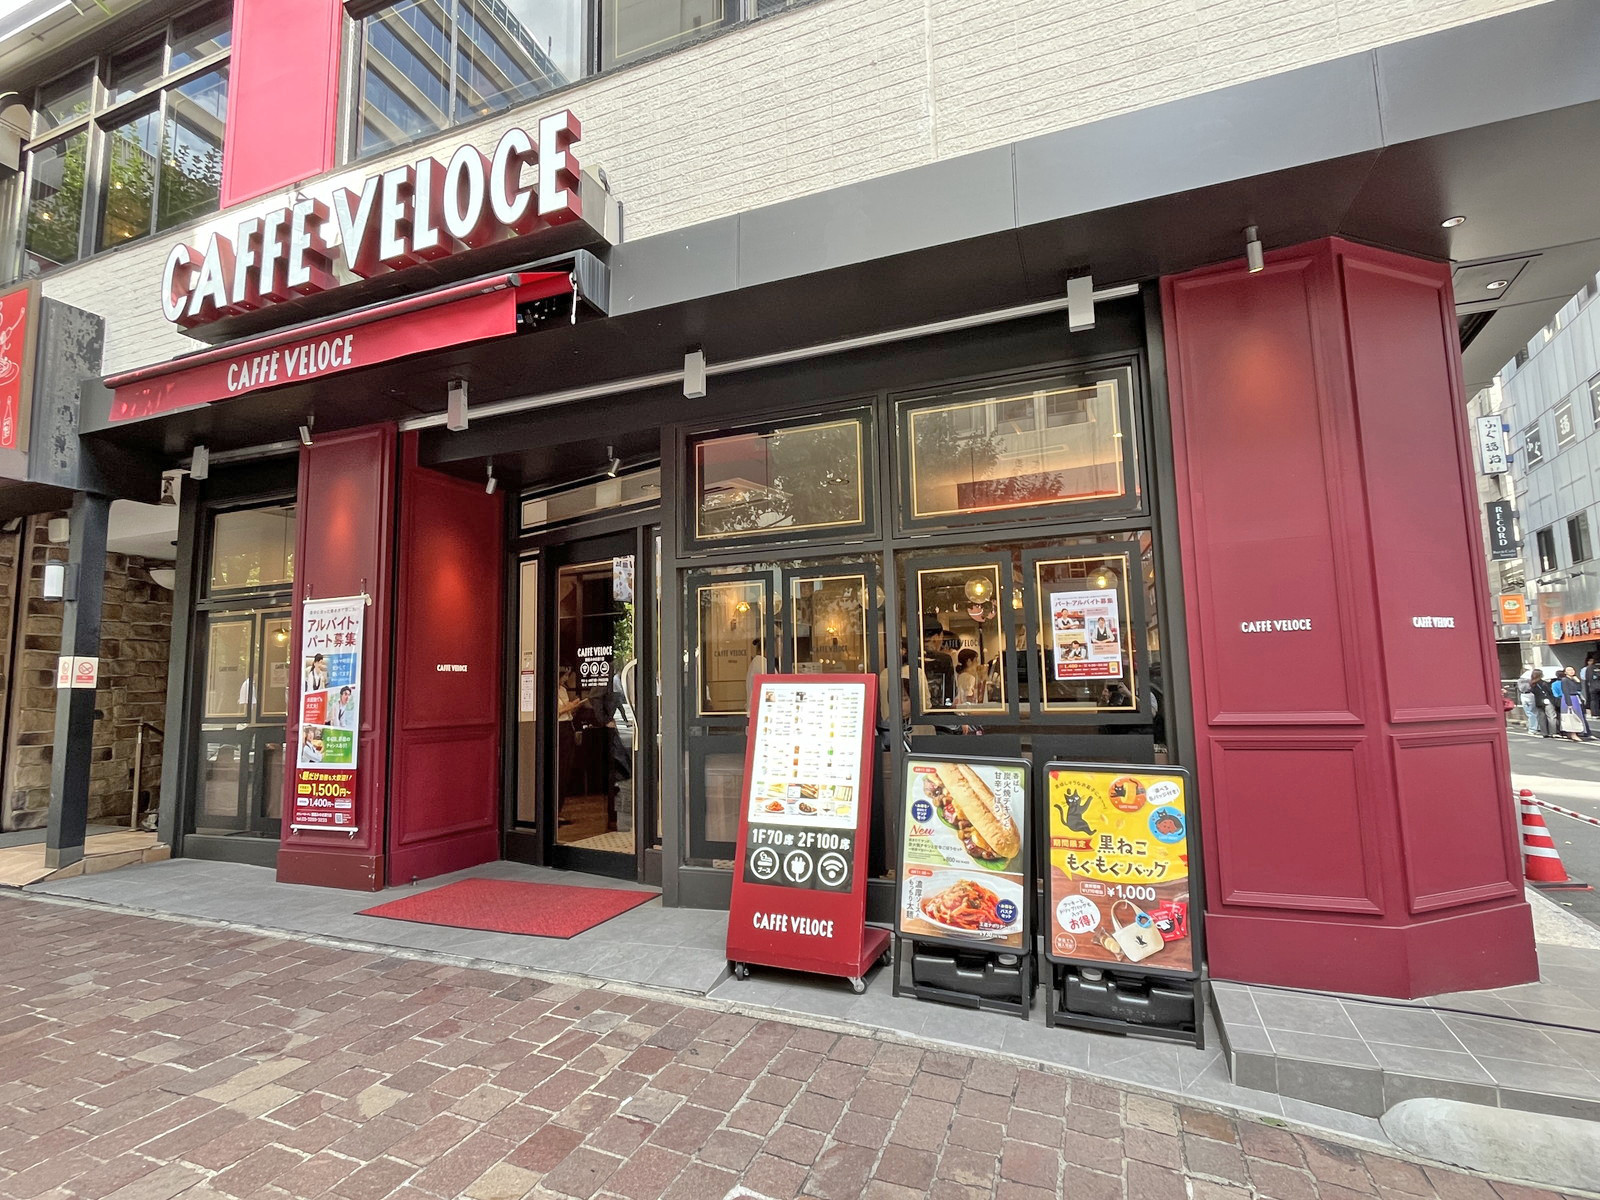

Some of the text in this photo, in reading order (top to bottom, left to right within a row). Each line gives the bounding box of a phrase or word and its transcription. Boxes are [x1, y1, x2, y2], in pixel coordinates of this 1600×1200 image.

[332, 109, 574, 273] VELOCE
[284, 334, 354, 378] VELOCE
[1495, 506, 1508, 546] RECORD
[1273, 618, 1312, 632] VELOCE
[307, 631, 357, 648] パート募集
[593, 645, 613, 656] VELOCE
[909, 825, 935, 837] New
[1053, 839, 1087, 848] 期間限定
[1098, 834, 1148, 855] 黒ねこ
[1067, 854, 1169, 878] もぐもぐバッグ
[1107, 884, 1156, 901] ¥1,000
[790, 916, 834, 938] VELOCE
